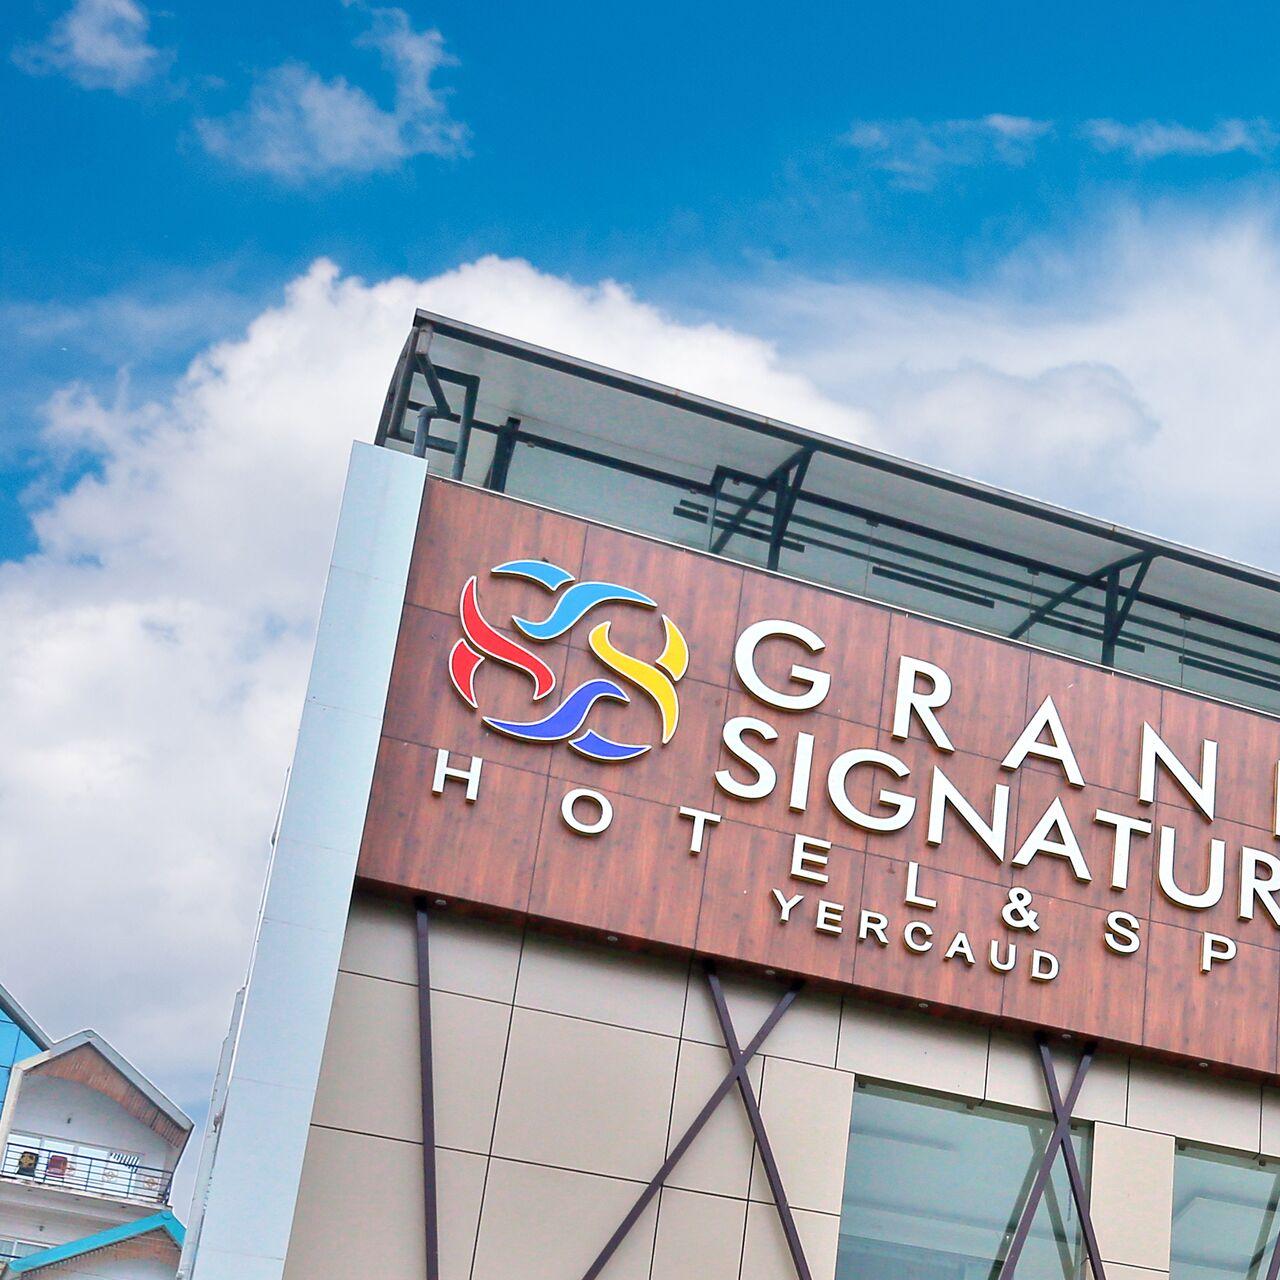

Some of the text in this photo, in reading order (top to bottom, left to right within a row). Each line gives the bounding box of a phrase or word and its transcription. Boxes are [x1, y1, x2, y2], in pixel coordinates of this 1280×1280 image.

[430, 747, 938, 910] HOTEL
[1002, 885, 1041, 933] &
[772, 887, 1060, 982] YERCAUD
